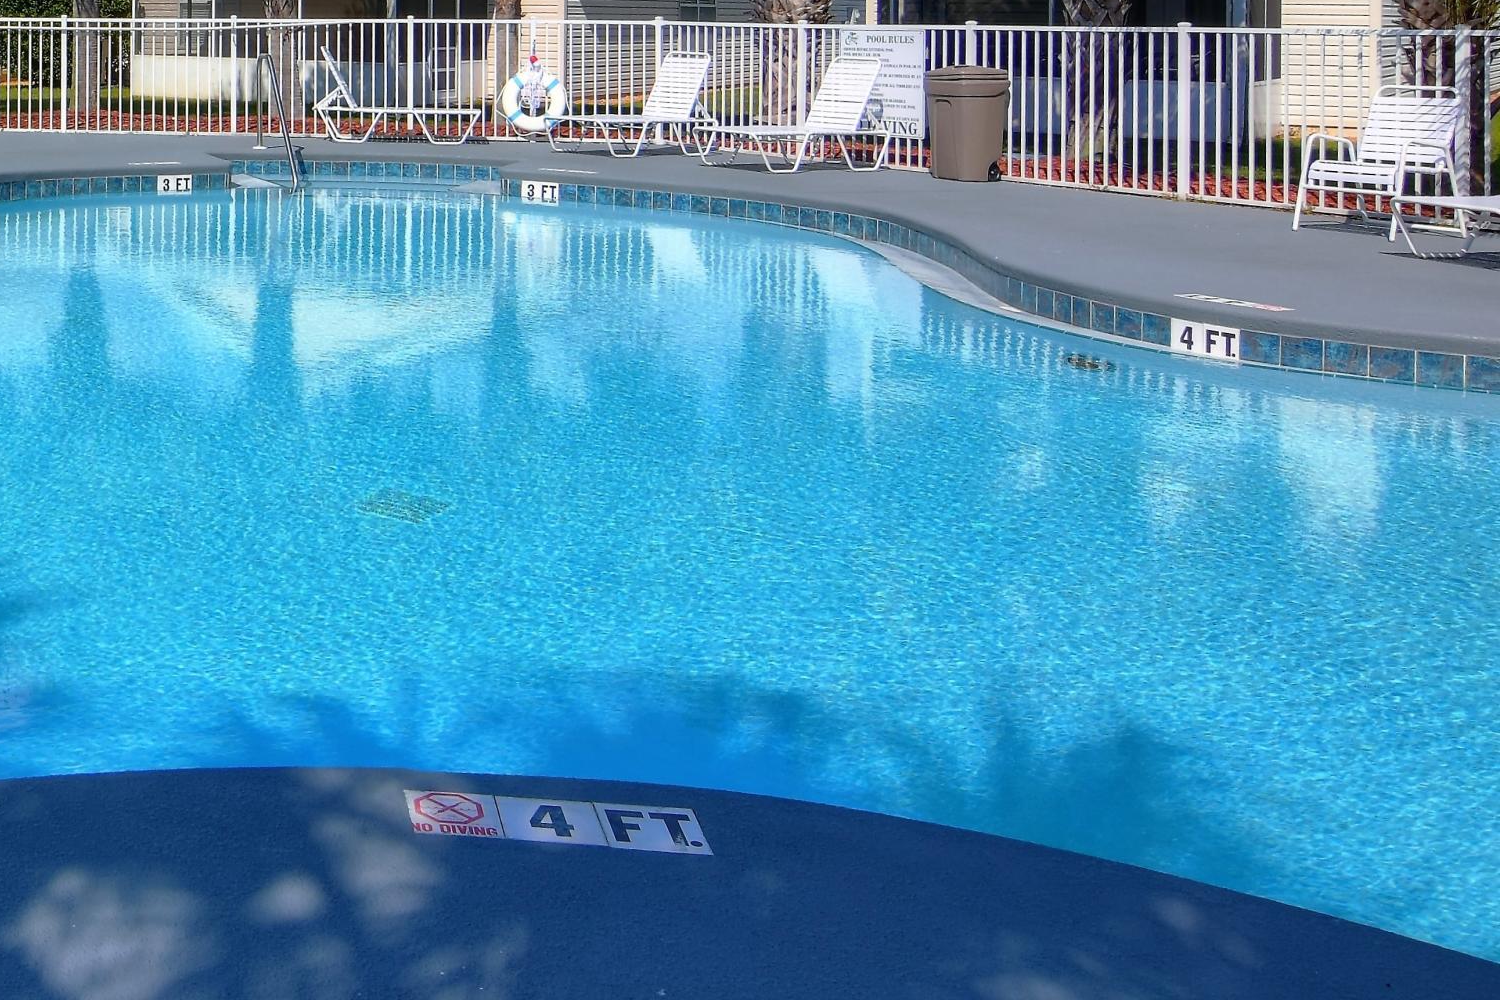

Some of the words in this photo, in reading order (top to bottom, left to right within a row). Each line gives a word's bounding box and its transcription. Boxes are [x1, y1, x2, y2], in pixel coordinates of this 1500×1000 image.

[866, 35, 887, 44] POOL
[888, 35, 915, 45] RULES
[163, 178, 170, 192] 3
[527, 184, 535, 197] 3
[1180, 326, 1194, 351] 4
[1206, 329, 1236, 358] FT.
[411, 821, 433, 833] NO
[439, 823, 498, 837] DIVING
[529, 804, 575, 838] 4
[604, 808, 704, 848] FT.
